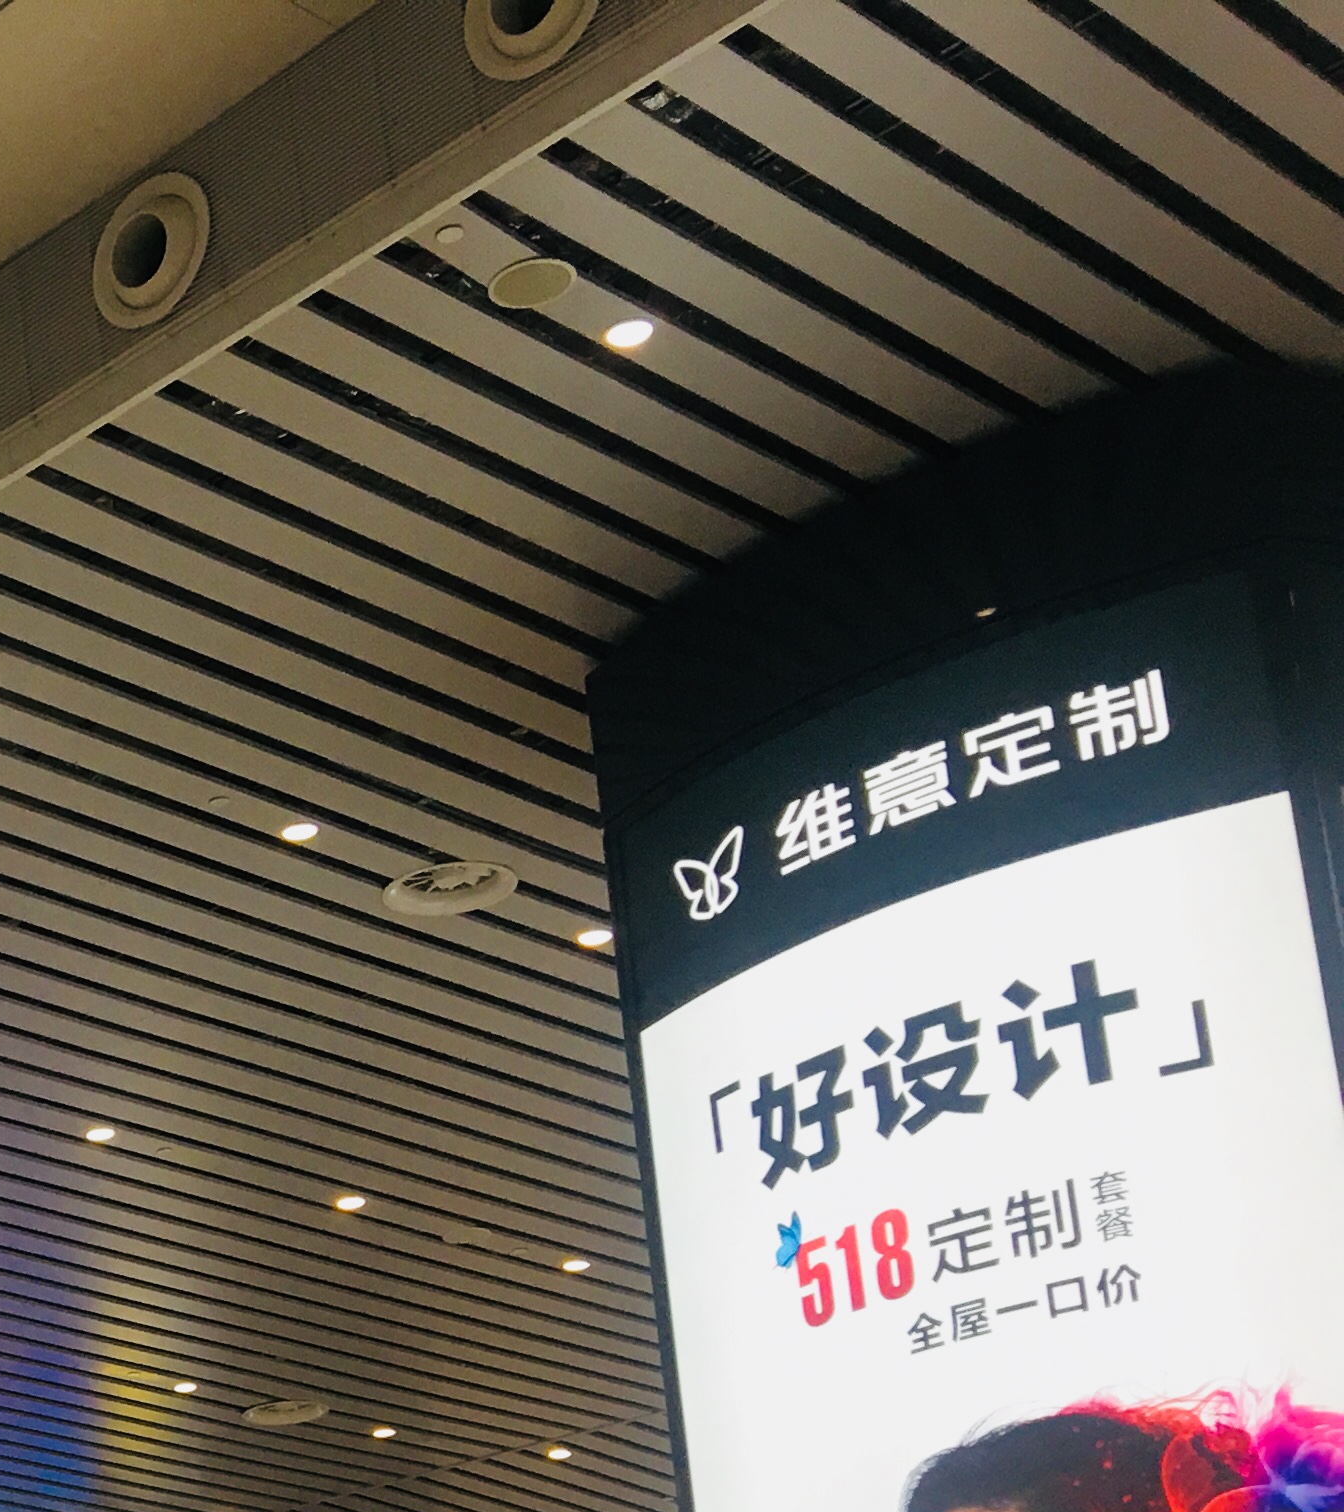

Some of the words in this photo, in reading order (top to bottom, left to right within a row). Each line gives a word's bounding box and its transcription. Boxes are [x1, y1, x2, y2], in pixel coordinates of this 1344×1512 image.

[774, 669, 1170, 876] 维意定制
[797, 1208, 916, 1328] 518
[927, 1178, 1082, 1283] 定制
[1089, 1170, 1134, 1243] 套餐
[907, 1264, 1142, 1355] 全屋一口价
